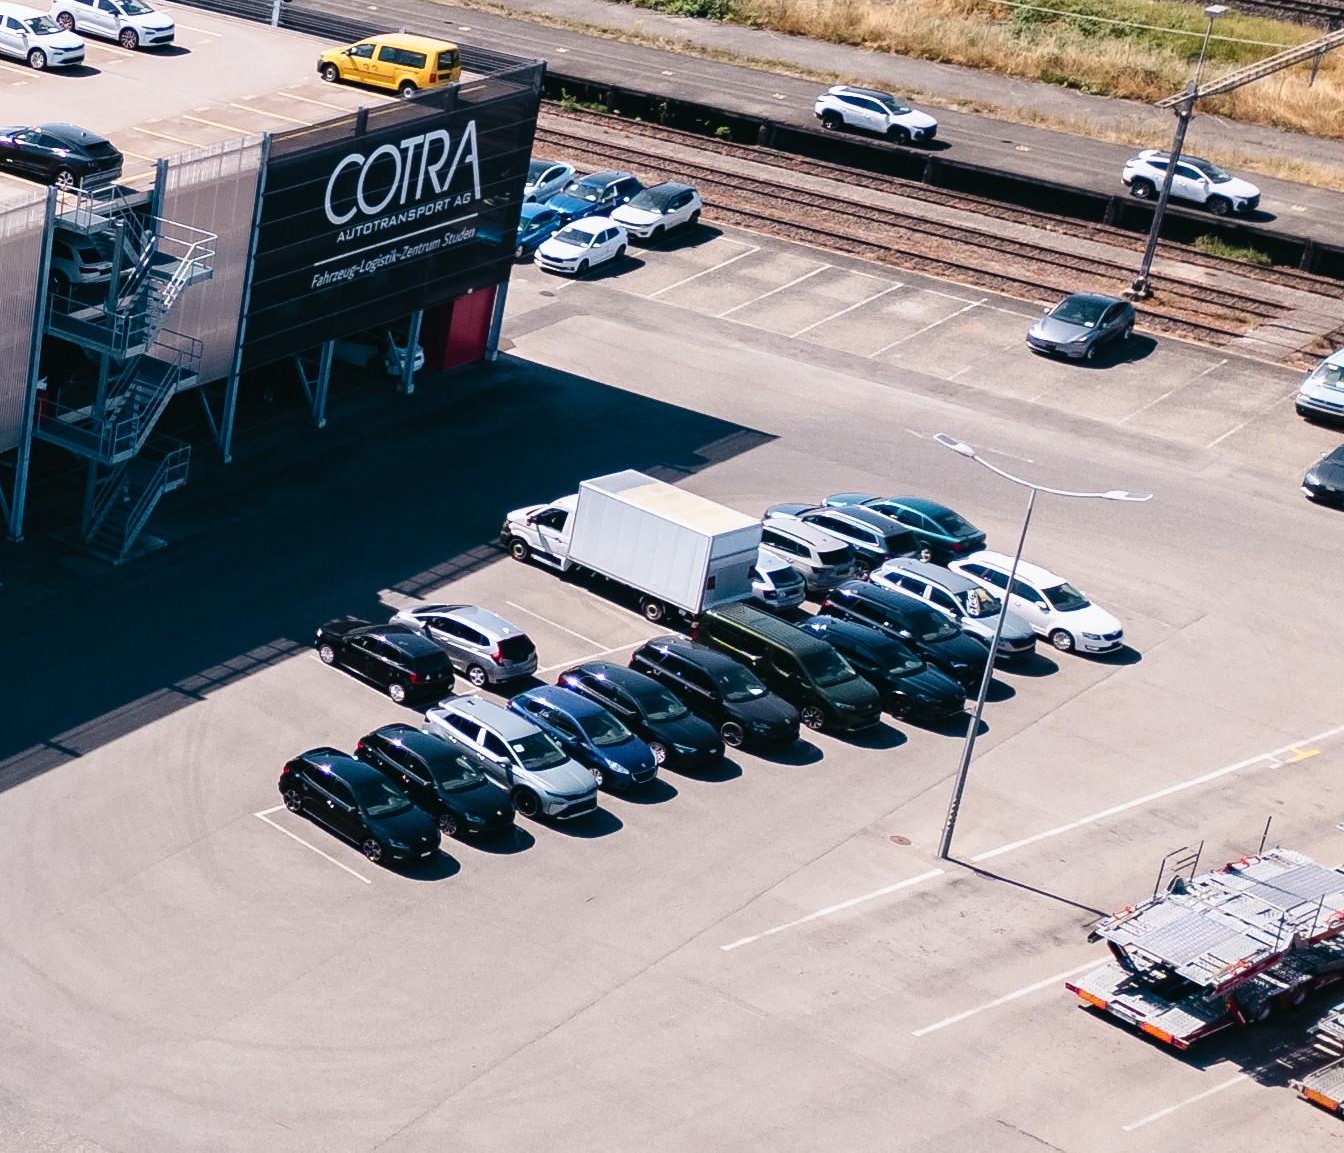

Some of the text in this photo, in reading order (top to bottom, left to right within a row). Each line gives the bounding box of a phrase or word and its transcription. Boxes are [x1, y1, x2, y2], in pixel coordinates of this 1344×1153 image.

[324, 119, 481, 225] COTRA
[336, 192, 472, 243] AUTOTRANSPORT AG
[310, 226, 477, 289] Fahrzeug-Logistik-Zentrum Studen
